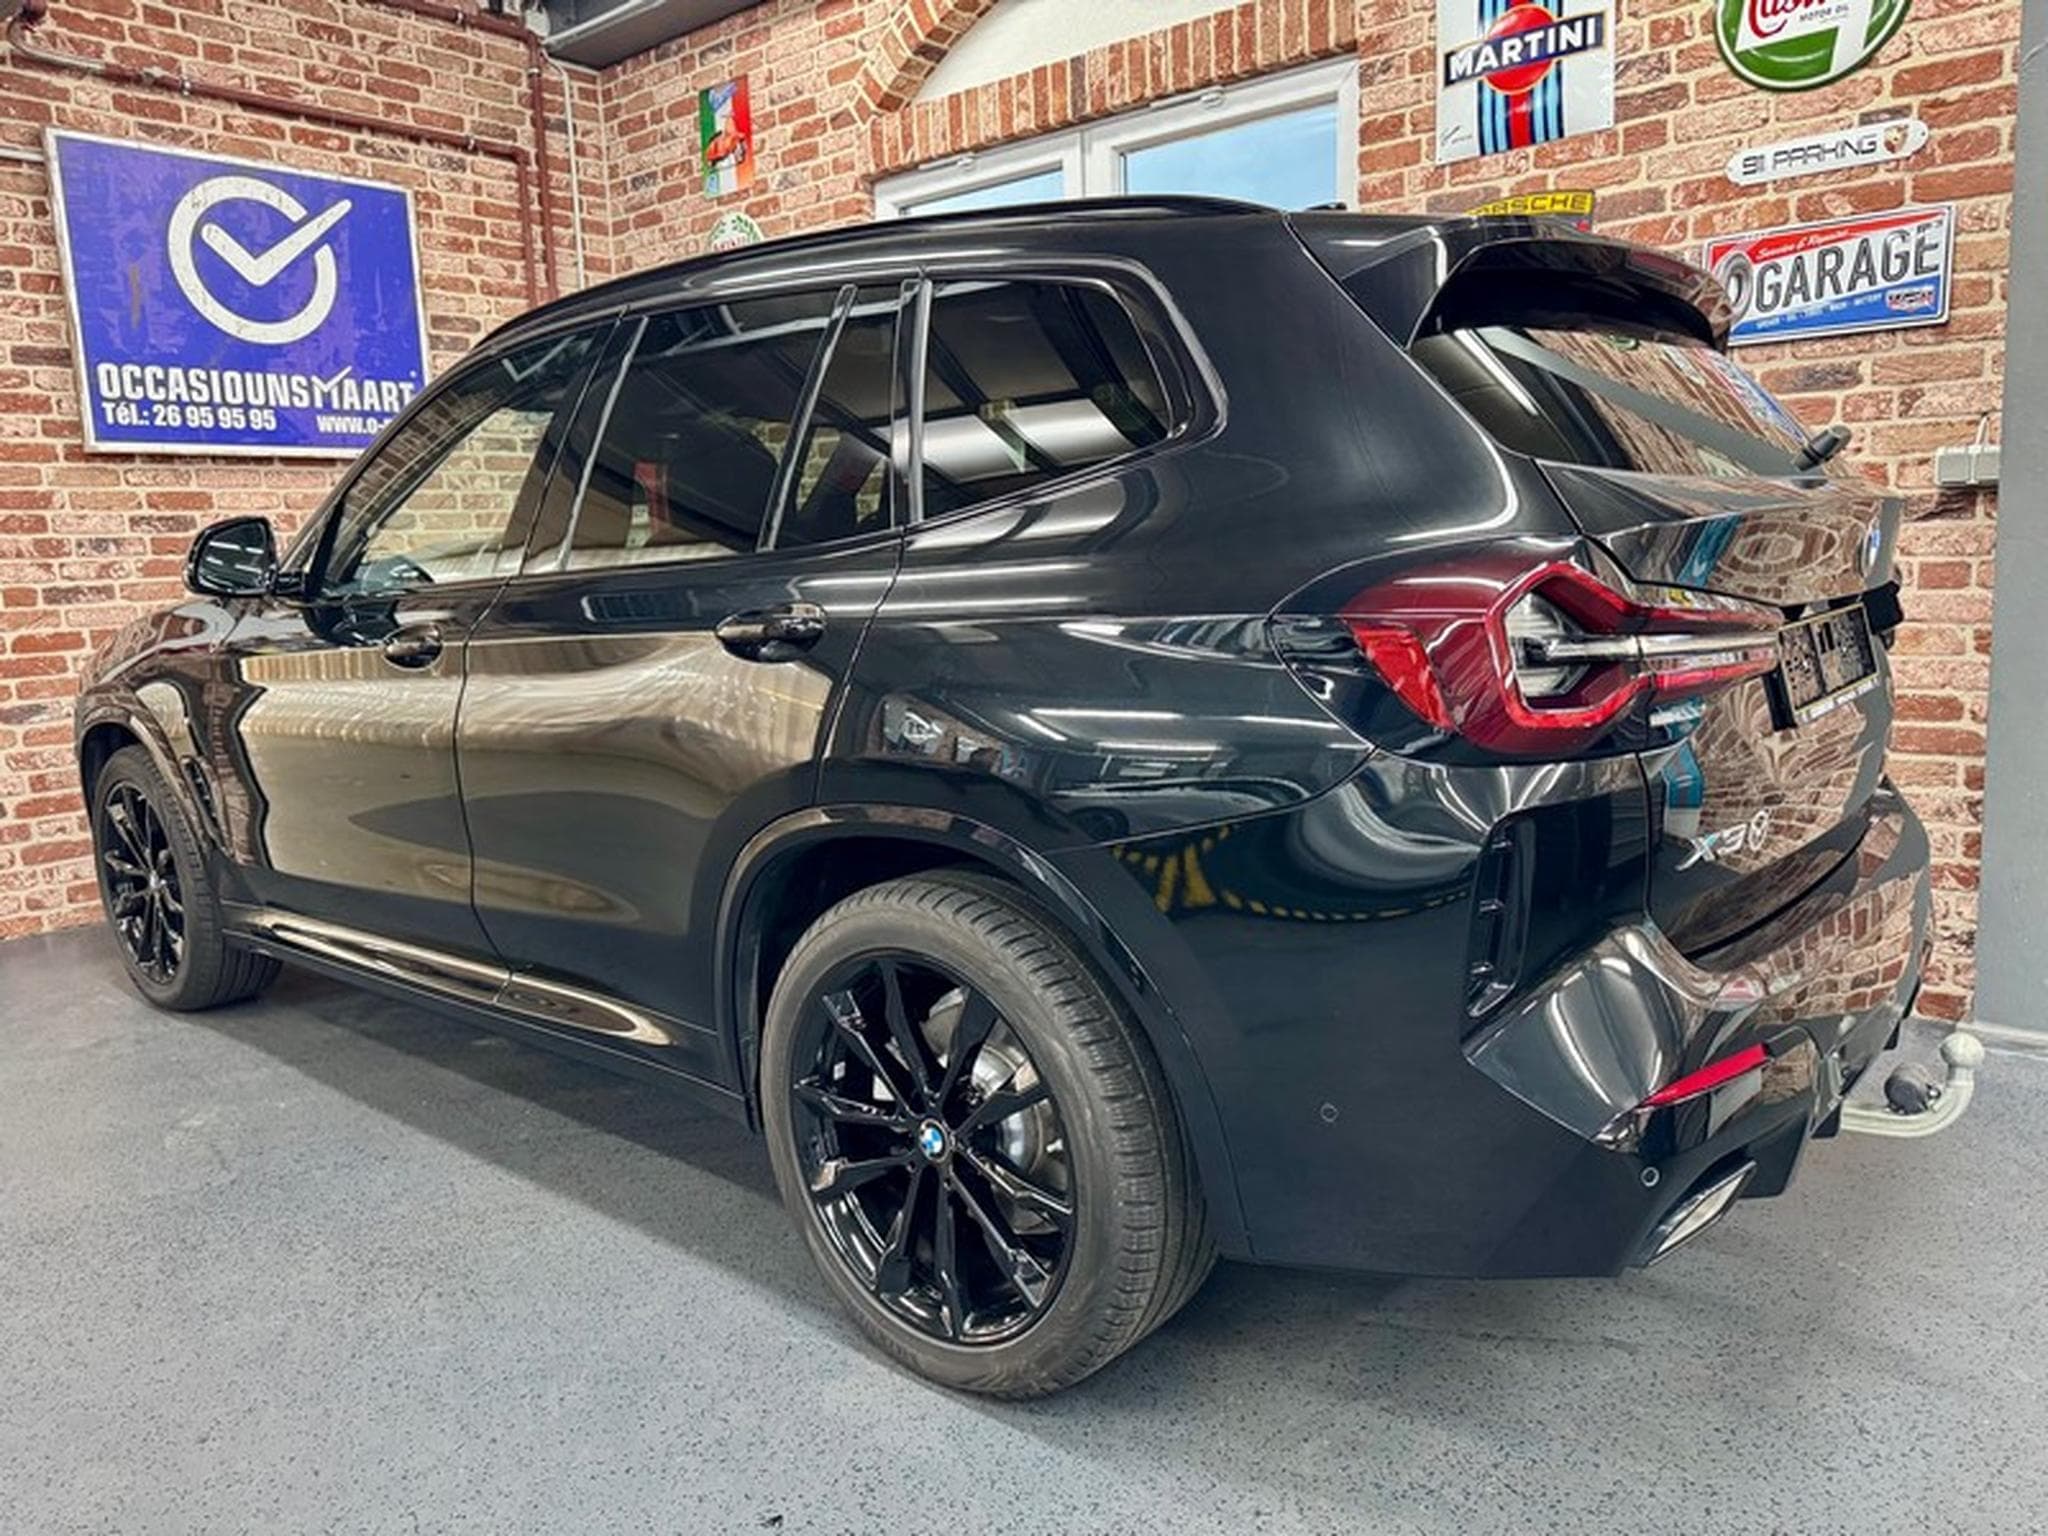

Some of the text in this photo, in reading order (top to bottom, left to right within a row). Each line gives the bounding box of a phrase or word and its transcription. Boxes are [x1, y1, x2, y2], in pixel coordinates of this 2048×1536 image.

[1450, 17, 1596, 80] MARTINI
[1772, 133, 1878, 172] PARKING
[1755, 220, 1943, 313] GARAGE
[97, 362, 415, 413] OCCASIOUNSMAART
[152, 403, 182, 428] 26
[185, 405, 214, 429] 95
[218, 406, 246, 430] 95
[249, 408, 277, 432] 95
